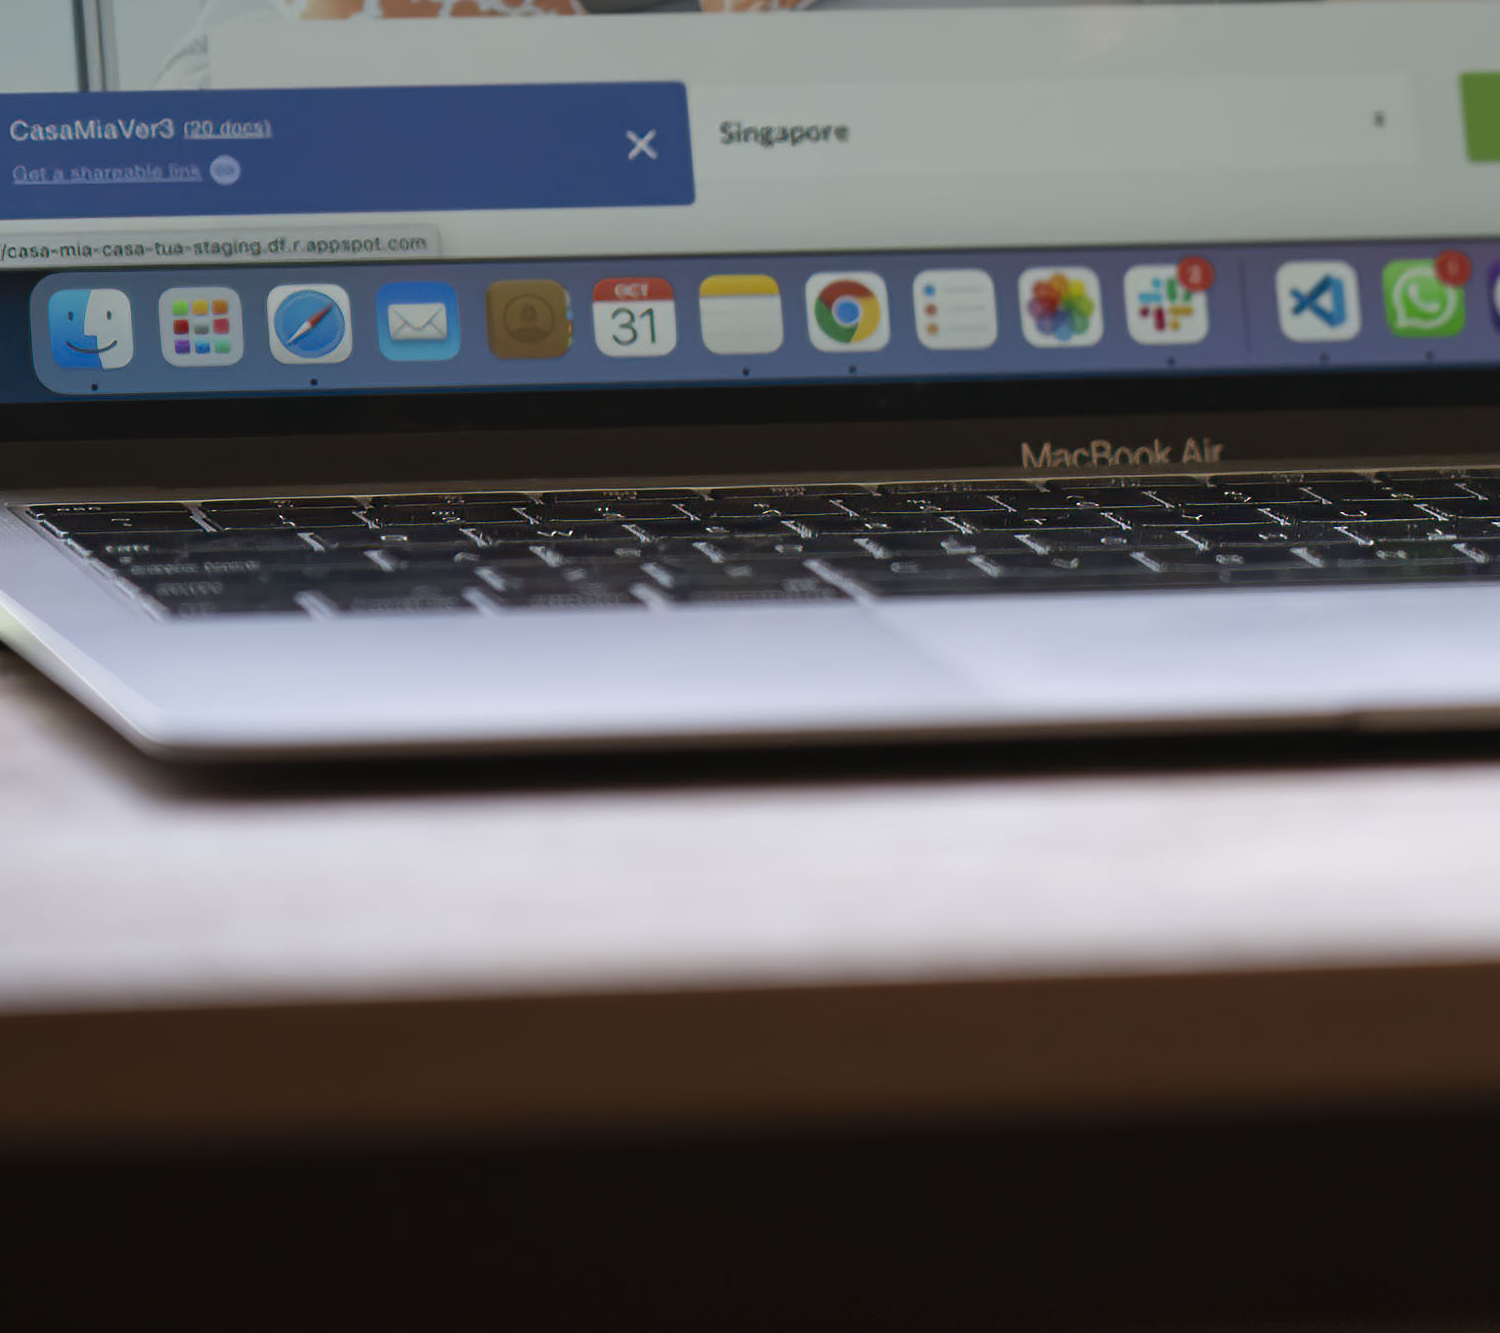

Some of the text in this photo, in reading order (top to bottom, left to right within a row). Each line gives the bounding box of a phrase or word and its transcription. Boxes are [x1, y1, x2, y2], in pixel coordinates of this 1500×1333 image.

[9, 118, 175, 142] CasaMiaVer3
[719, 120, 850, 148] Singapore
[610, 306, 658, 346] 31
[1020, 436, 1225, 471] MacBook Air
